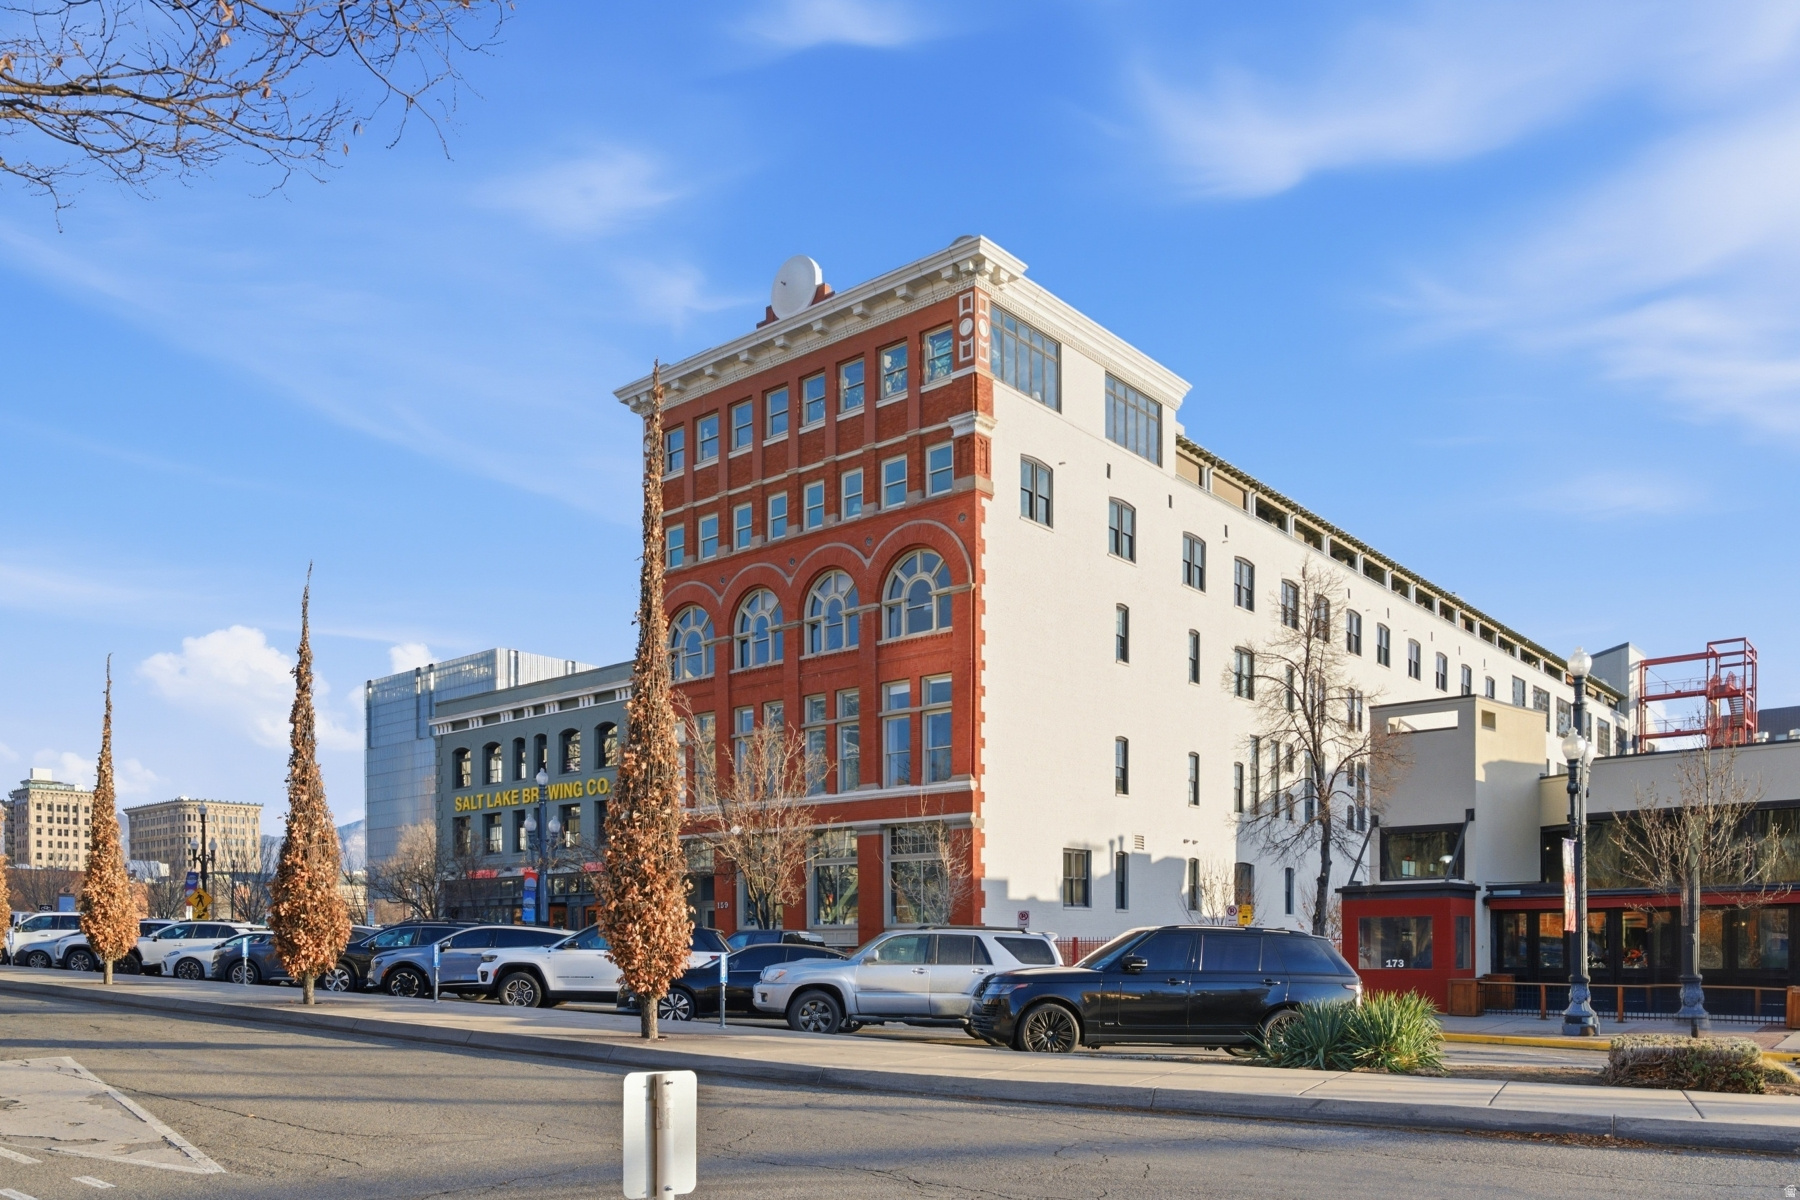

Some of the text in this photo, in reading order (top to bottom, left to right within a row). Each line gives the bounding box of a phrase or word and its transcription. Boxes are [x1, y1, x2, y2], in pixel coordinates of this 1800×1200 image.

[455, 793, 484, 812] SALT
[486, 789, 519, 809] LAKE
[586, 777, 611, 796] CO.
[1385, 959, 1405, 968] 173
